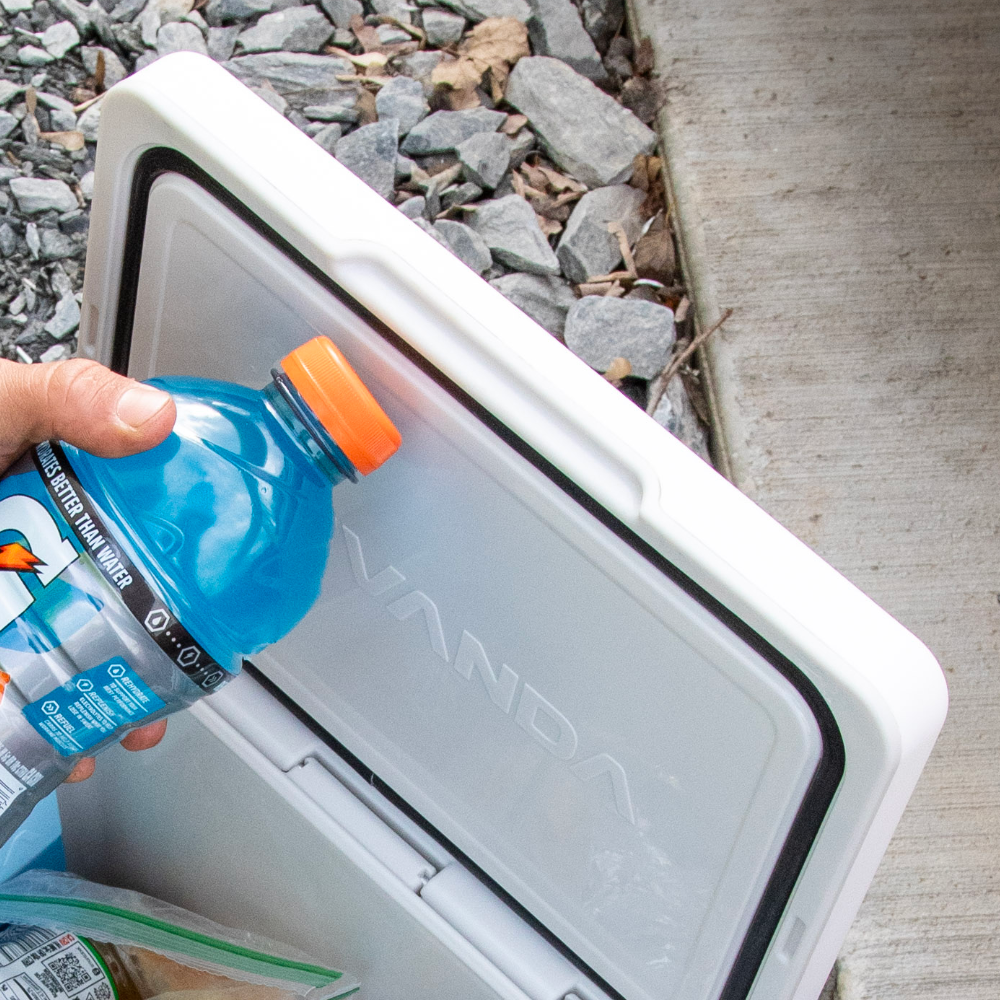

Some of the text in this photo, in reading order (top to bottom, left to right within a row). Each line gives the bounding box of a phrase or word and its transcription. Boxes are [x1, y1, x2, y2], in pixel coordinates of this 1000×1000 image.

[49, 472, 85, 518] BETTER
[74, 512, 105, 550] THAN
[96, 546, 134, 590] WATER
[120, 674, 151, 704] REHYDRATE
[88, 690, 116, 718] REPLENISH
[53, 712, 75, 734] REFUEL
